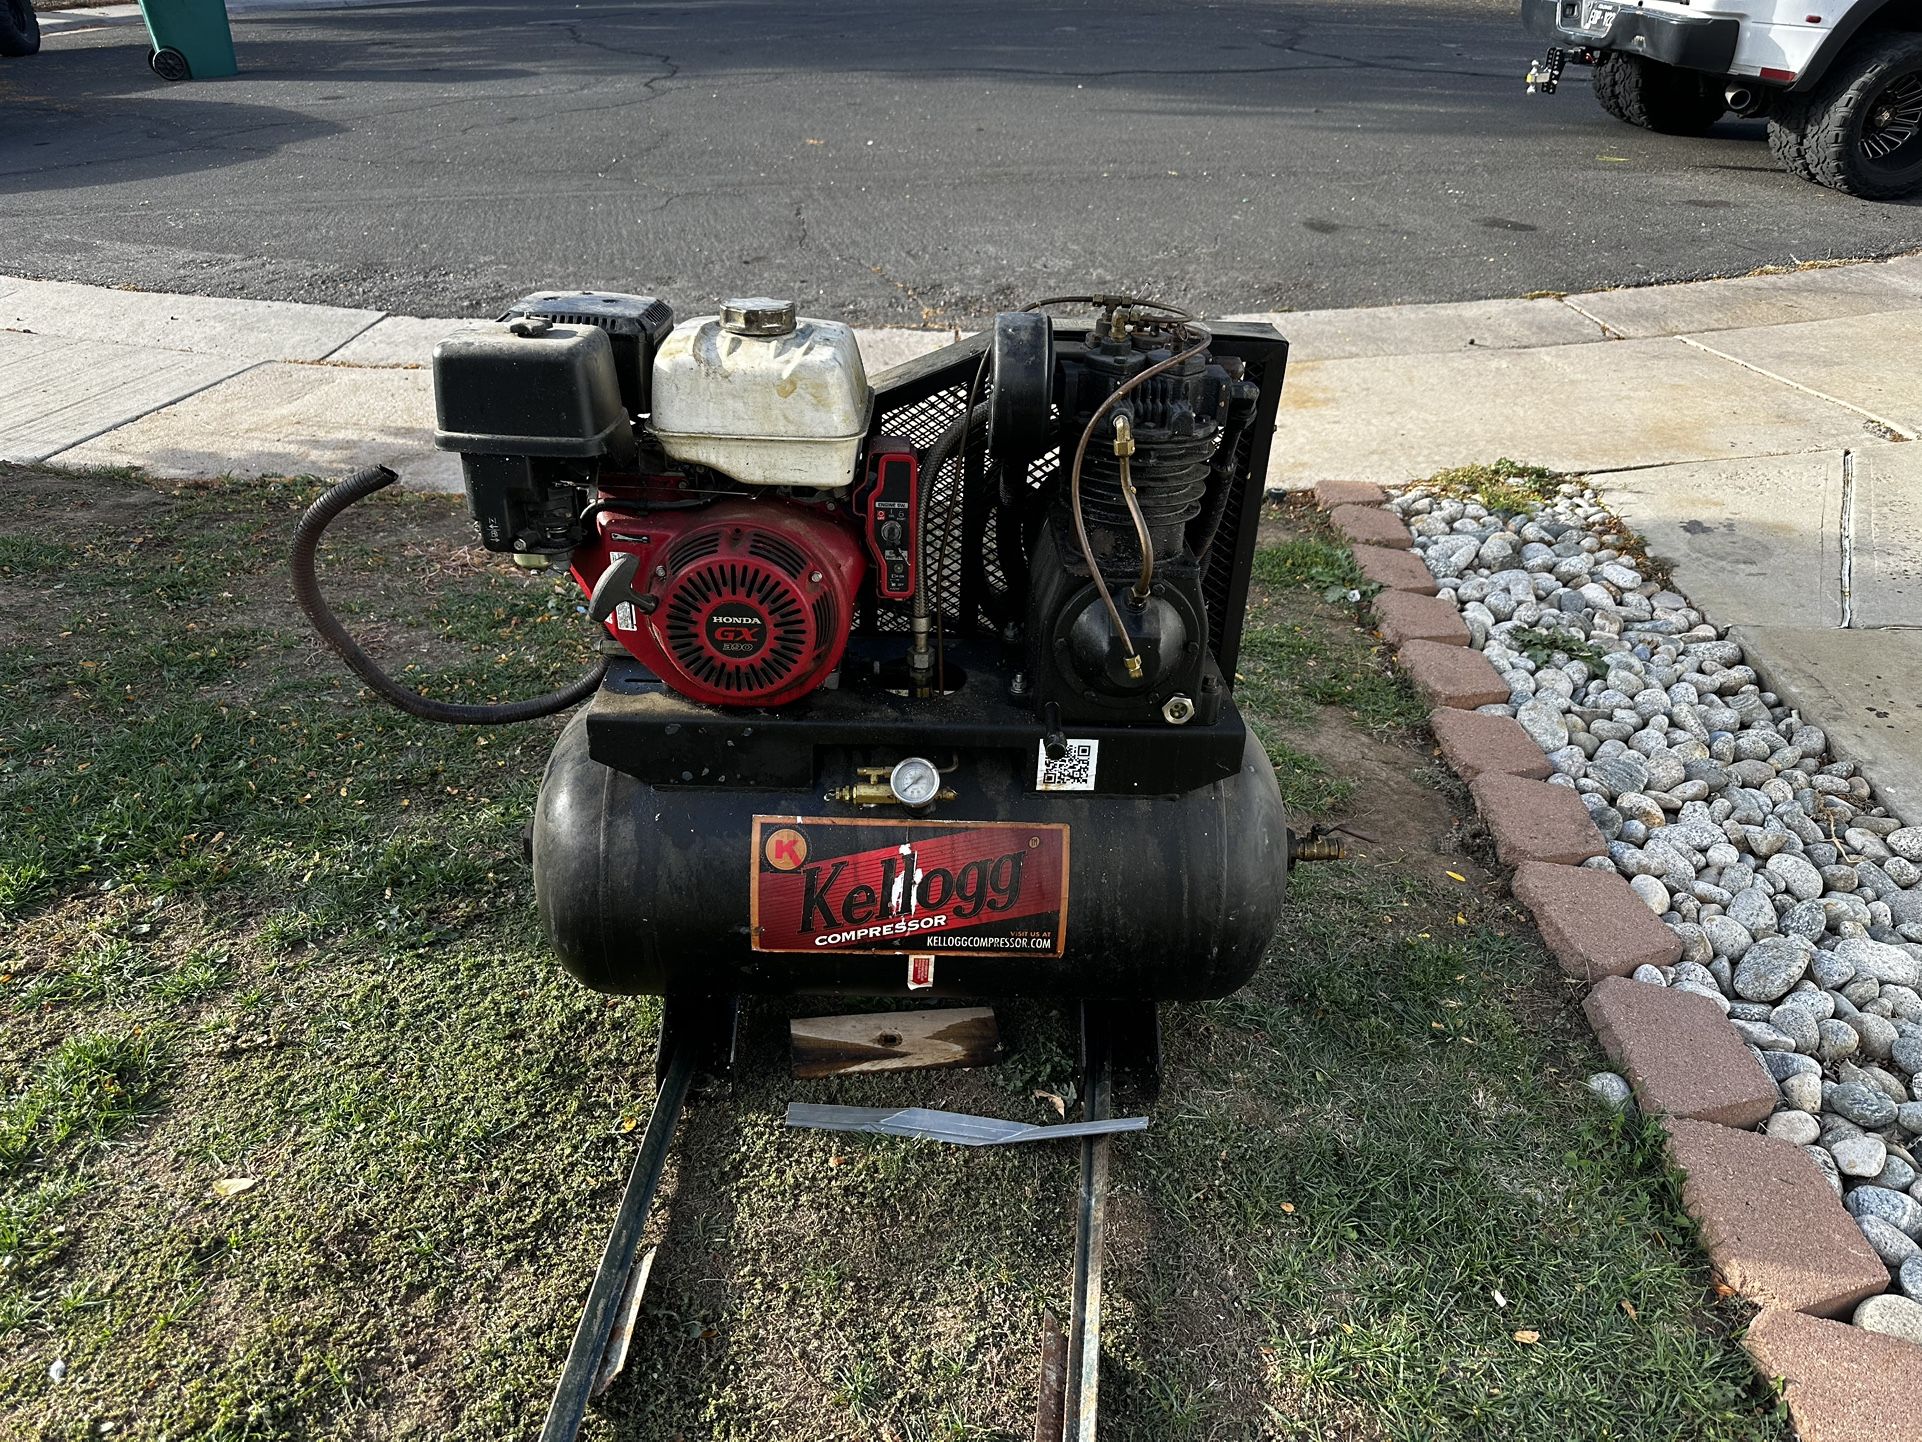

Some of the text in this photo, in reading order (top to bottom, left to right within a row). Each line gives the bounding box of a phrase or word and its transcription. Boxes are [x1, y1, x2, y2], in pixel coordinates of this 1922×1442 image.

[712, 616, 761, 624] HONDA
[715, 627, 760, 641] GX
[775, 839, 800, 866] K
[796, 850, 1027, 933] Kellogg
[815, 915, 947, 946] COMPRESSOR
[926, 935, 1051, 949] KELLOGGCOMPRESSOR.COM
